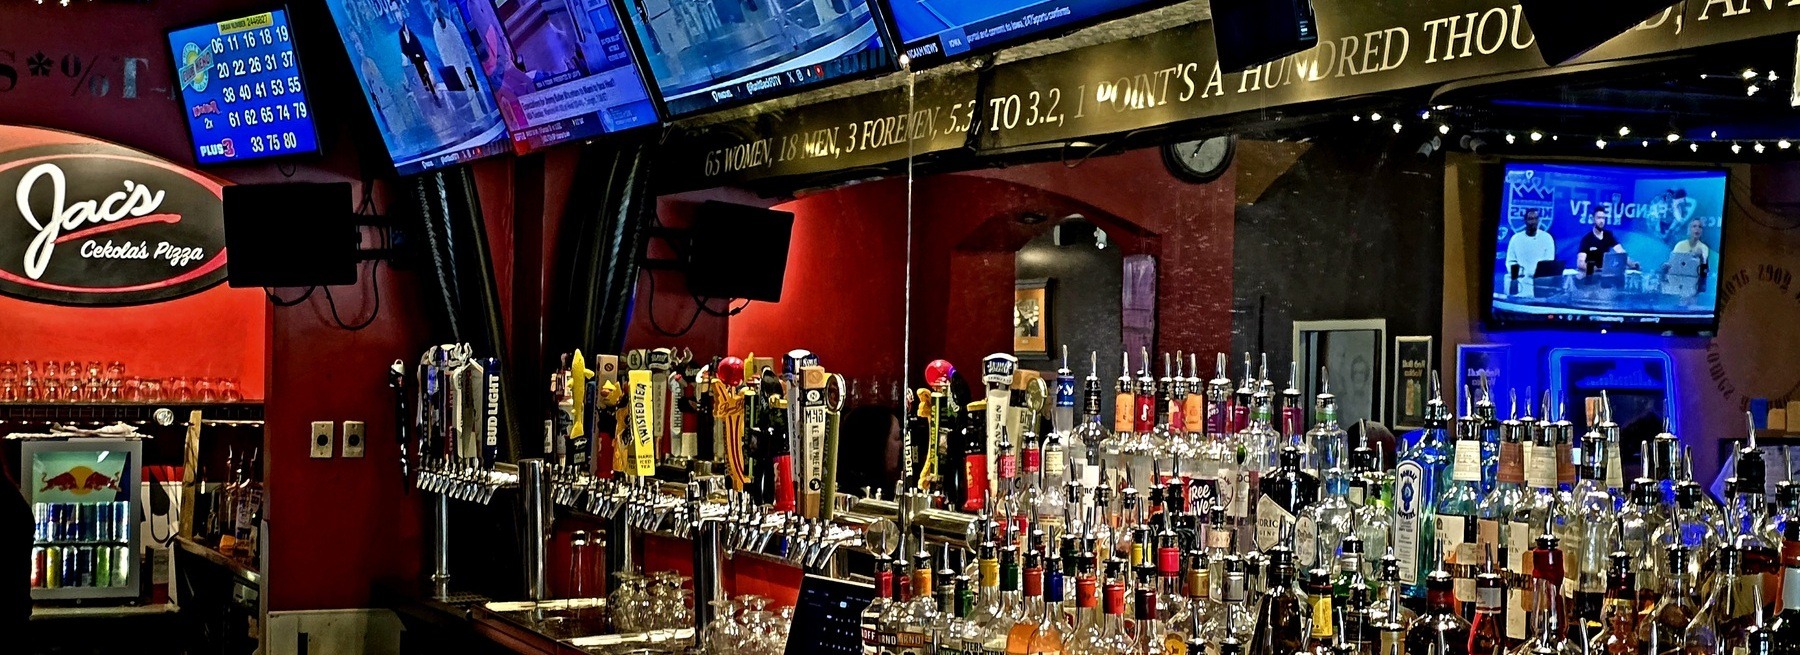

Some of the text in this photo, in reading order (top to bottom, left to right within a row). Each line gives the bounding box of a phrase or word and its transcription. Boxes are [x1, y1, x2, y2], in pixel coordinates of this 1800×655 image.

[212, 25, 288, 54] 06 11 16 18 19
[217, 50, 293, 78] 20 22 26 31 37
[223, 76, 301, 103] 38 40 41 53 55
[705, 150, 720, 177] 65
[724, 138, 773, 172] WOMEN,
[778, 136, 798, 162] 18
[801, 127, 840, 159] MEN,
[846, 123, 857, 153] 3
[860, 107, 941, 150] FOREMEN,
[990, 94, 1021, 132] TO
[1026, 88, 1065, 127] 3.2,
[1074, 85, 1086, 119] 1
[1096, 62, 1198, 113] POINT'S
[1201, 59, 1224, 98] A
[1237, 26, 1410, 93] HUNDRED
[229, 102, 306, 128] 61 62 65 74 79
[251, 132, 296, 152] 33 75 80
[16, 163, 165, 280] Jac's
[80, 240, 204, 266] Cekola's Pizza
[487, 374, 499, 446] BUD LIGHT
[634, 383, 650, 445] TWISTED TEA
